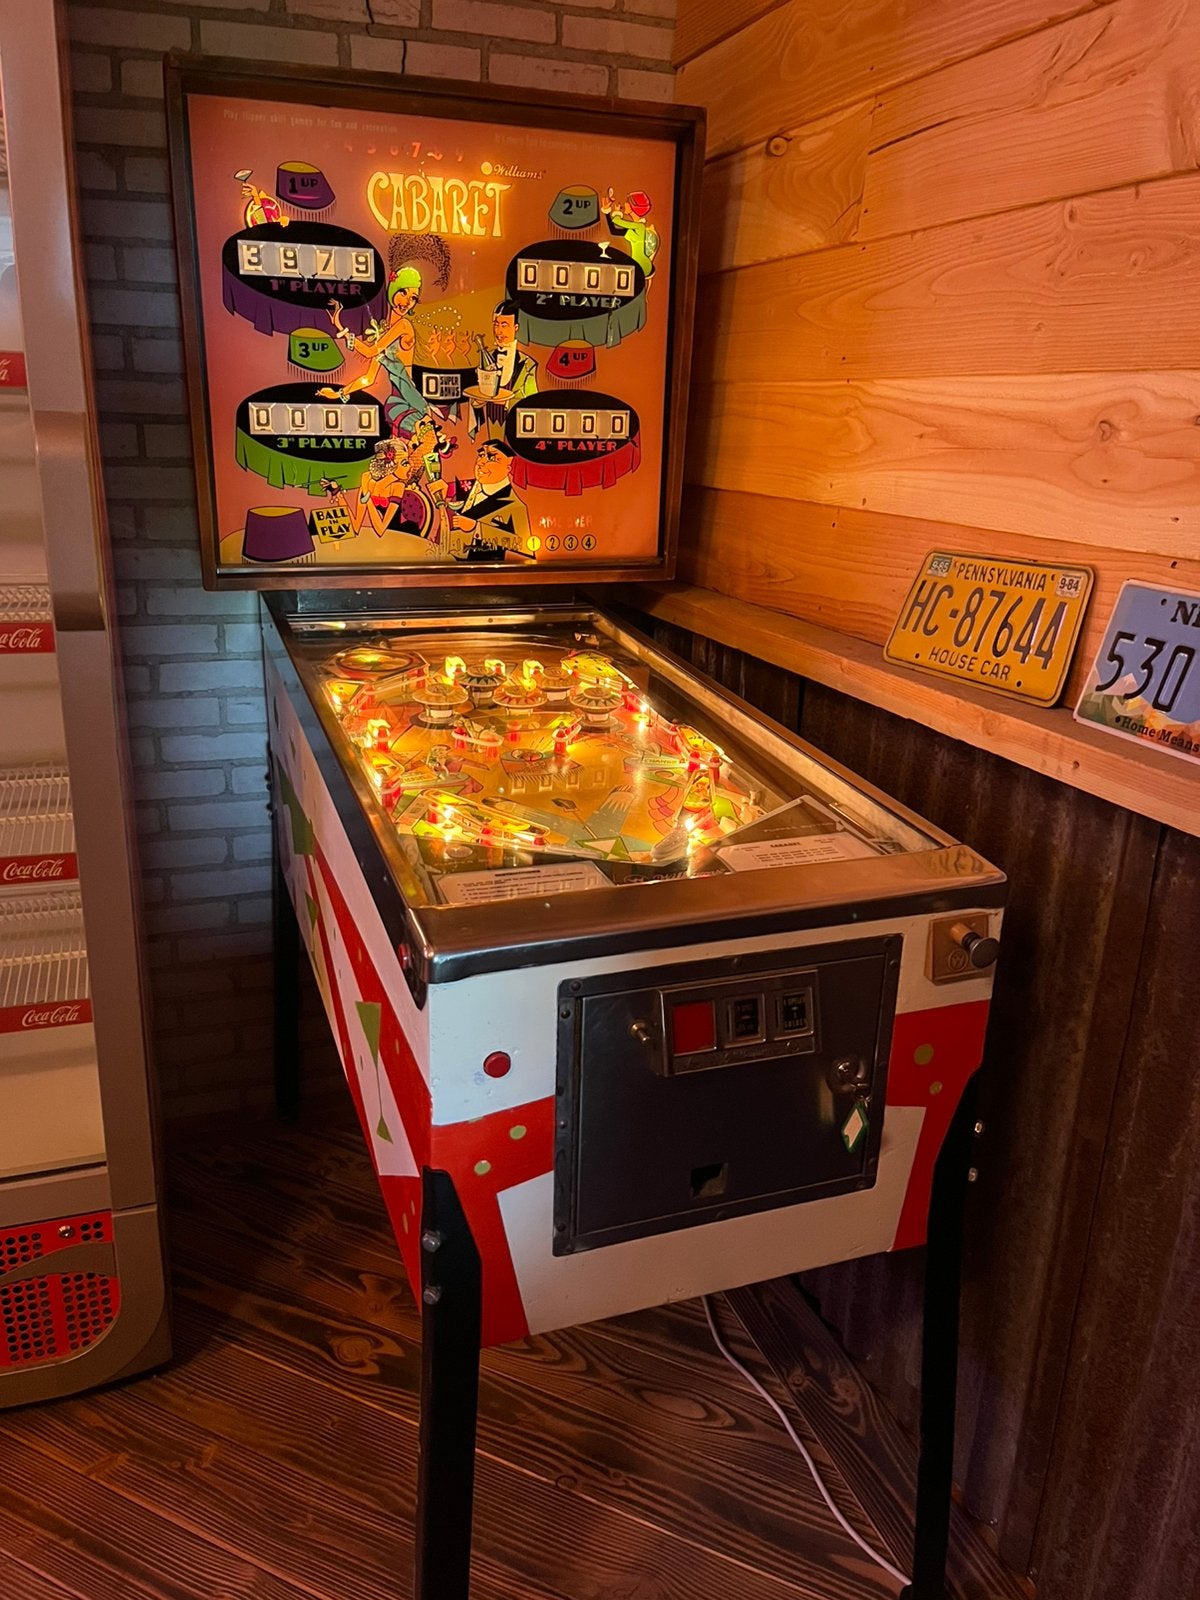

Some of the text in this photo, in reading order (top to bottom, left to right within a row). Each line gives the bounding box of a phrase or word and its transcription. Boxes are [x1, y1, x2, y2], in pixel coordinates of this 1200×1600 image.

[493, 163, 544, 181] Williams
[301, 177, 319, 188] UP
[366, 171, 512, 237] CABARET
[562, 199, 591, 215] 2 UP
[290, 280, 361, 295] PLAYER
[559, 294, 622, 309] PLAYER
[299, 342, 329, 358] 3 UP
[559, 352, 588, 366] 4 UP
[298, 437, 366, 449] PLAYER
[558, 440, 617, 451] PLAYER
[316, 508, 349, 521] BALL
[320, 523, 351, 536] PLAY
[956, 562, 1047, 592] PENNSYLVANIA
[1058, 575, 1081, 592] 9-84
[901, 579, 1068, 670] HC-87644
[928, 647, 1012, 682] HOUSE CAR
[1120, 715, 1200, 753] Home Means
[3, 858, 65, 881] Coca-Cola
[21, 1004, 81, 1027] Coca-Cola
